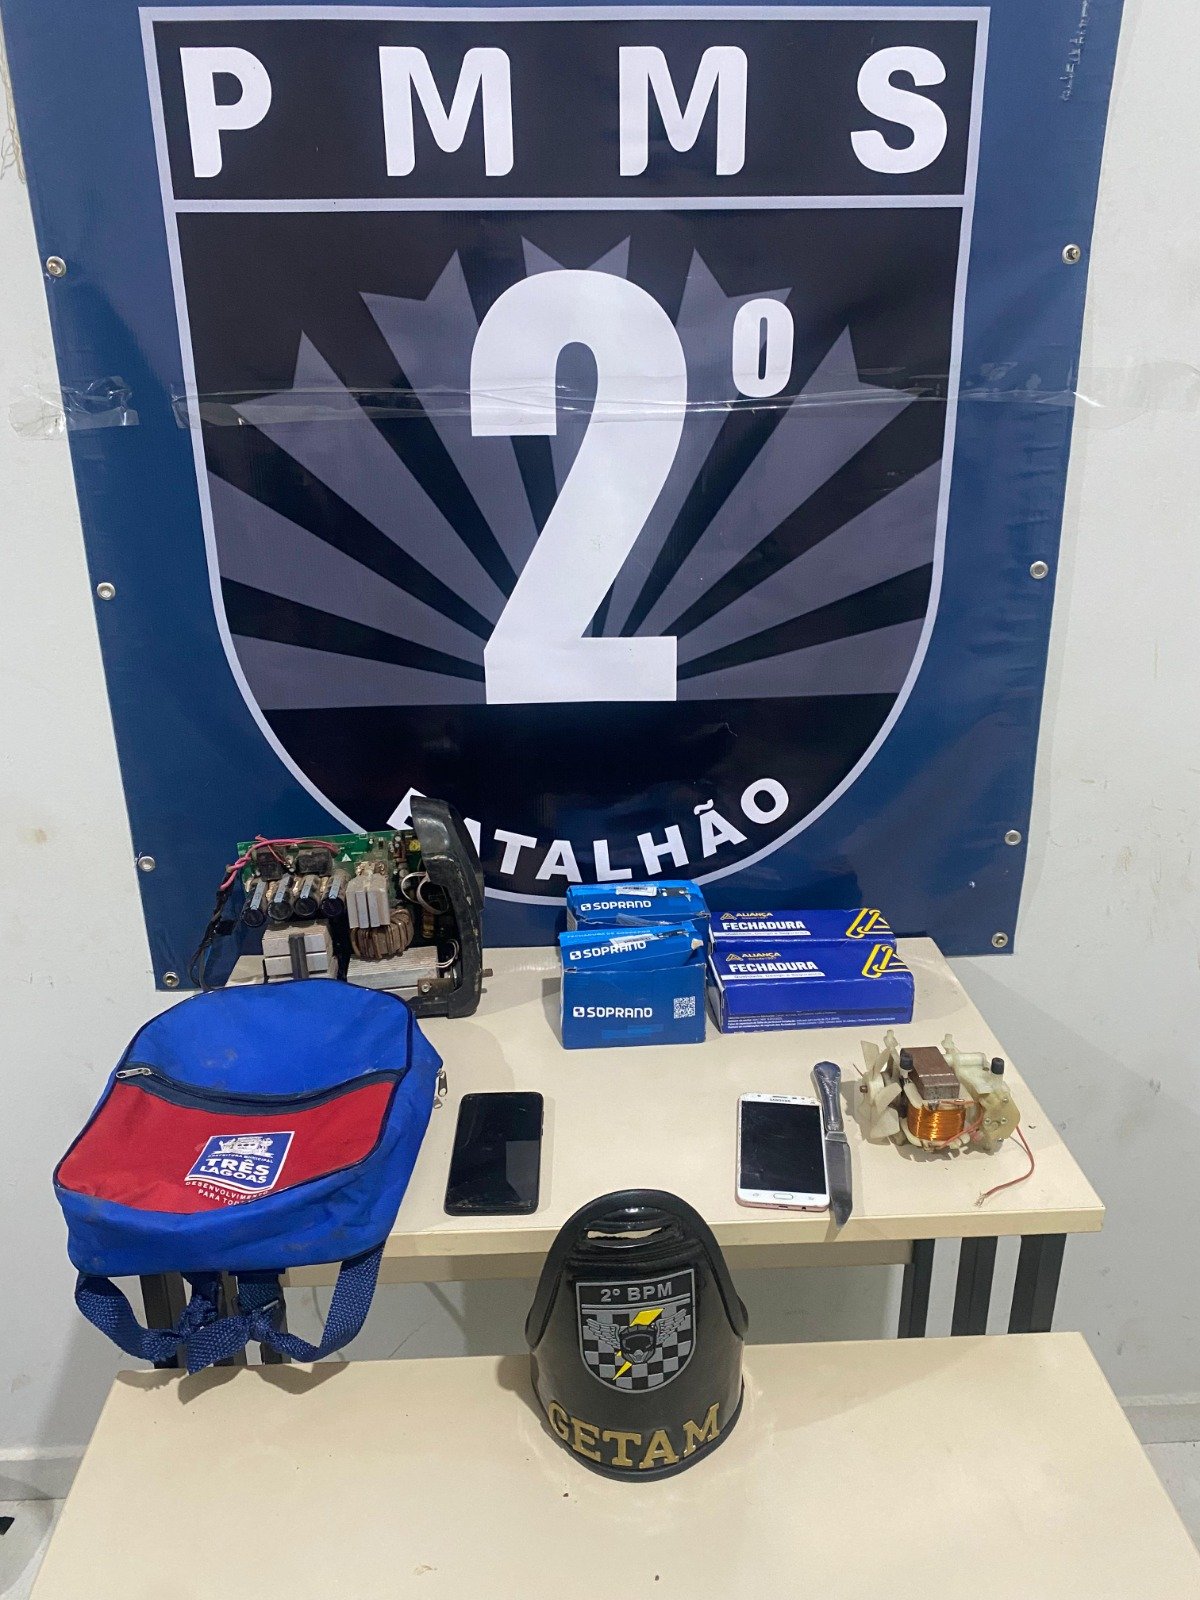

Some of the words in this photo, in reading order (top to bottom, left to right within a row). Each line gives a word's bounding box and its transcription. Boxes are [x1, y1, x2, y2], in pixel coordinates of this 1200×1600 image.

[386, 777, 791, 883] TALHÃO
[592, 900, 652, 911] SOPRANO
[721, 920, 807, 931] FECHADURA
[582, 940, 647, 959] SOPRANO
[728, 960, 819, 973] FECHADURA
[586, 1006, 653, 1019] SOPRANO
[199, 1165, 267, 1184] LAGOAS
[205, 1158, 270, 1176] TRÊS
[197, 1188, 220, 1202] PARA
[627, 1281, 673, 1302] BPM
[549, 1400, 721, 1469] GETAM
